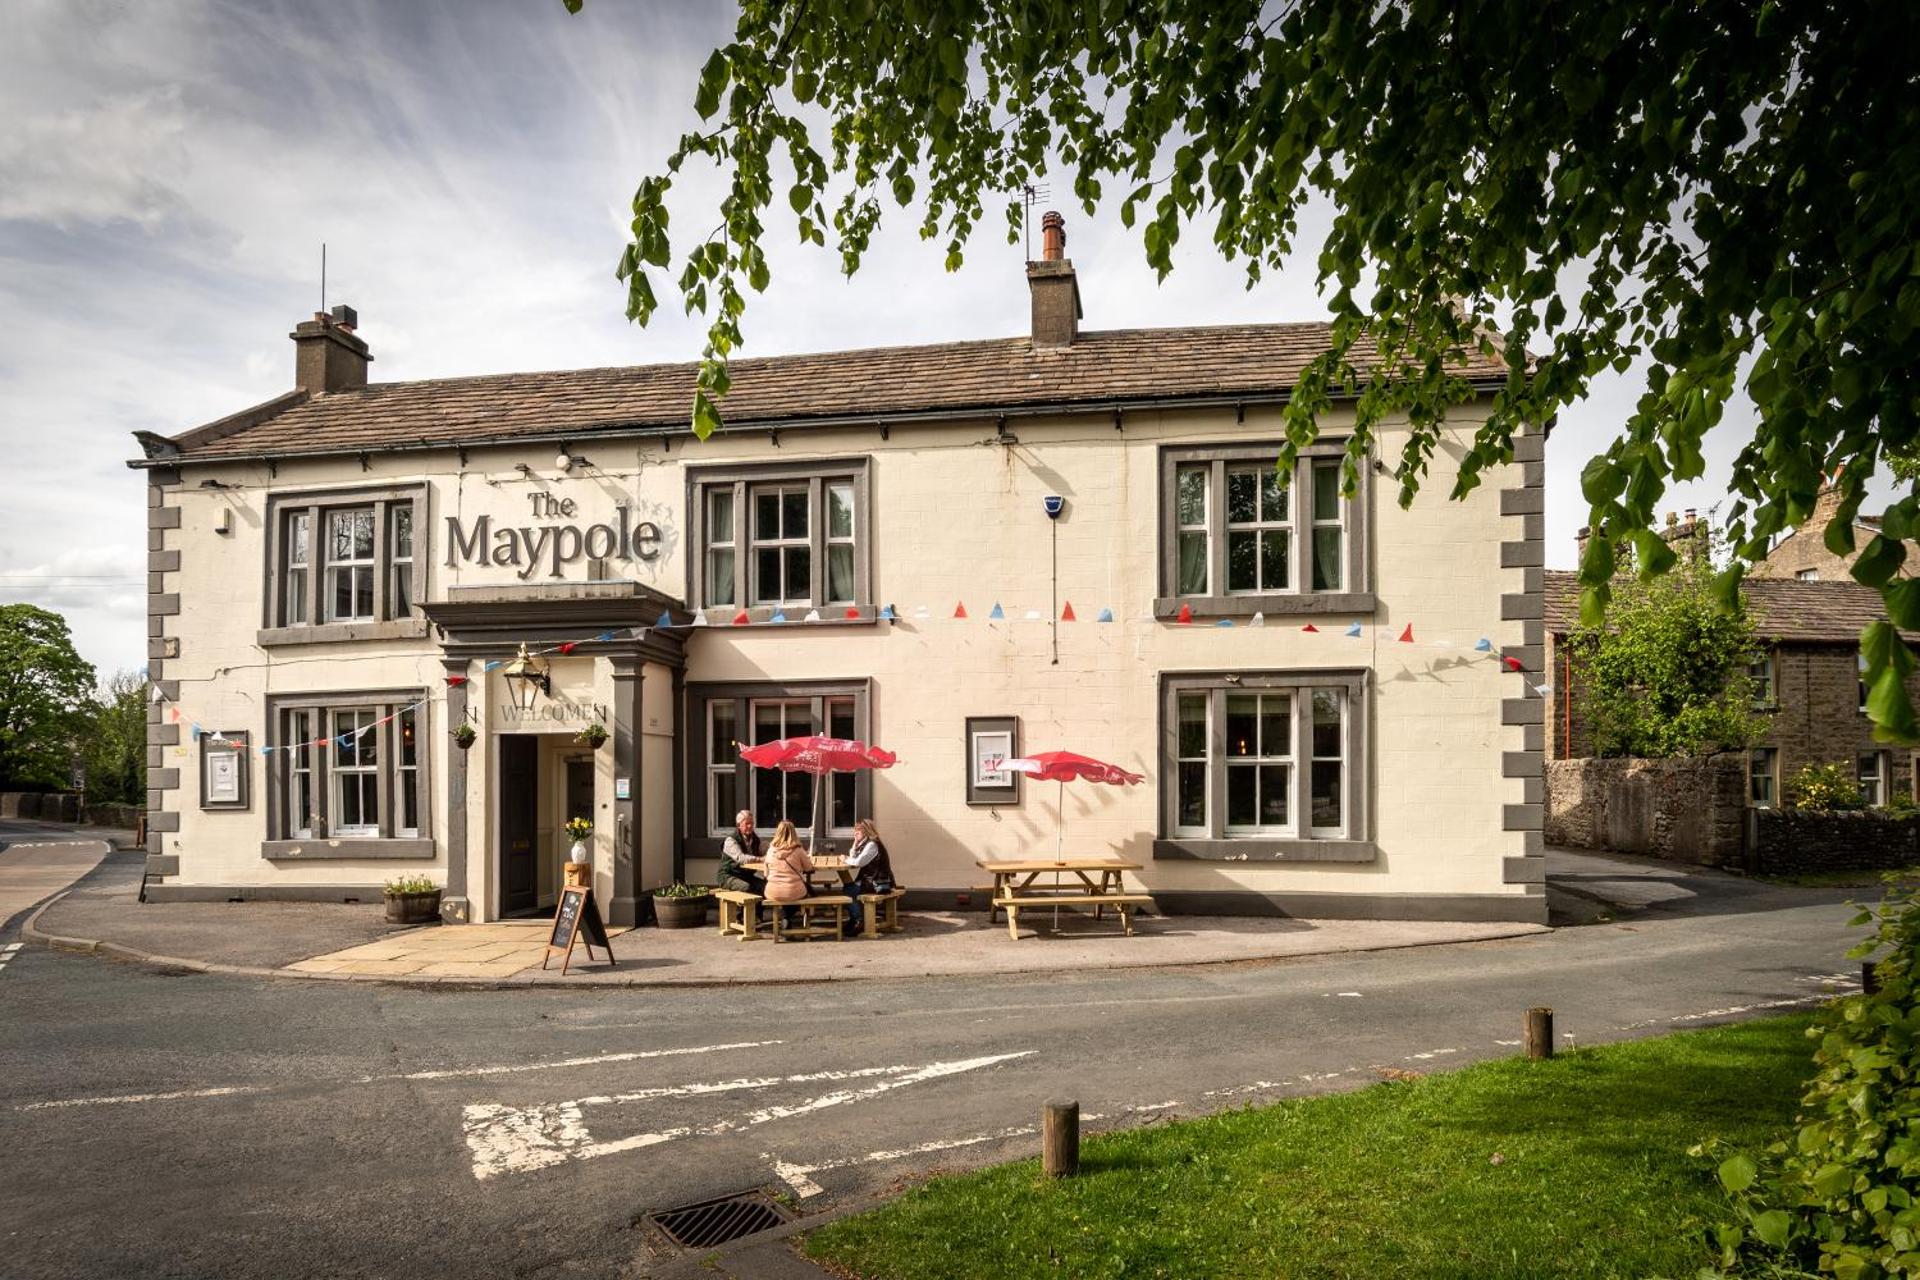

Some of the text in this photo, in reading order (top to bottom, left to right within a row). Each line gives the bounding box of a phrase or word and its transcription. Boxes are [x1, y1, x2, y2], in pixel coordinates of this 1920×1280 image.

[527, 490, 575, 517] The
[443, 506, 661, 579] Maypole
[501, 703, 593, 722] WELCOME
